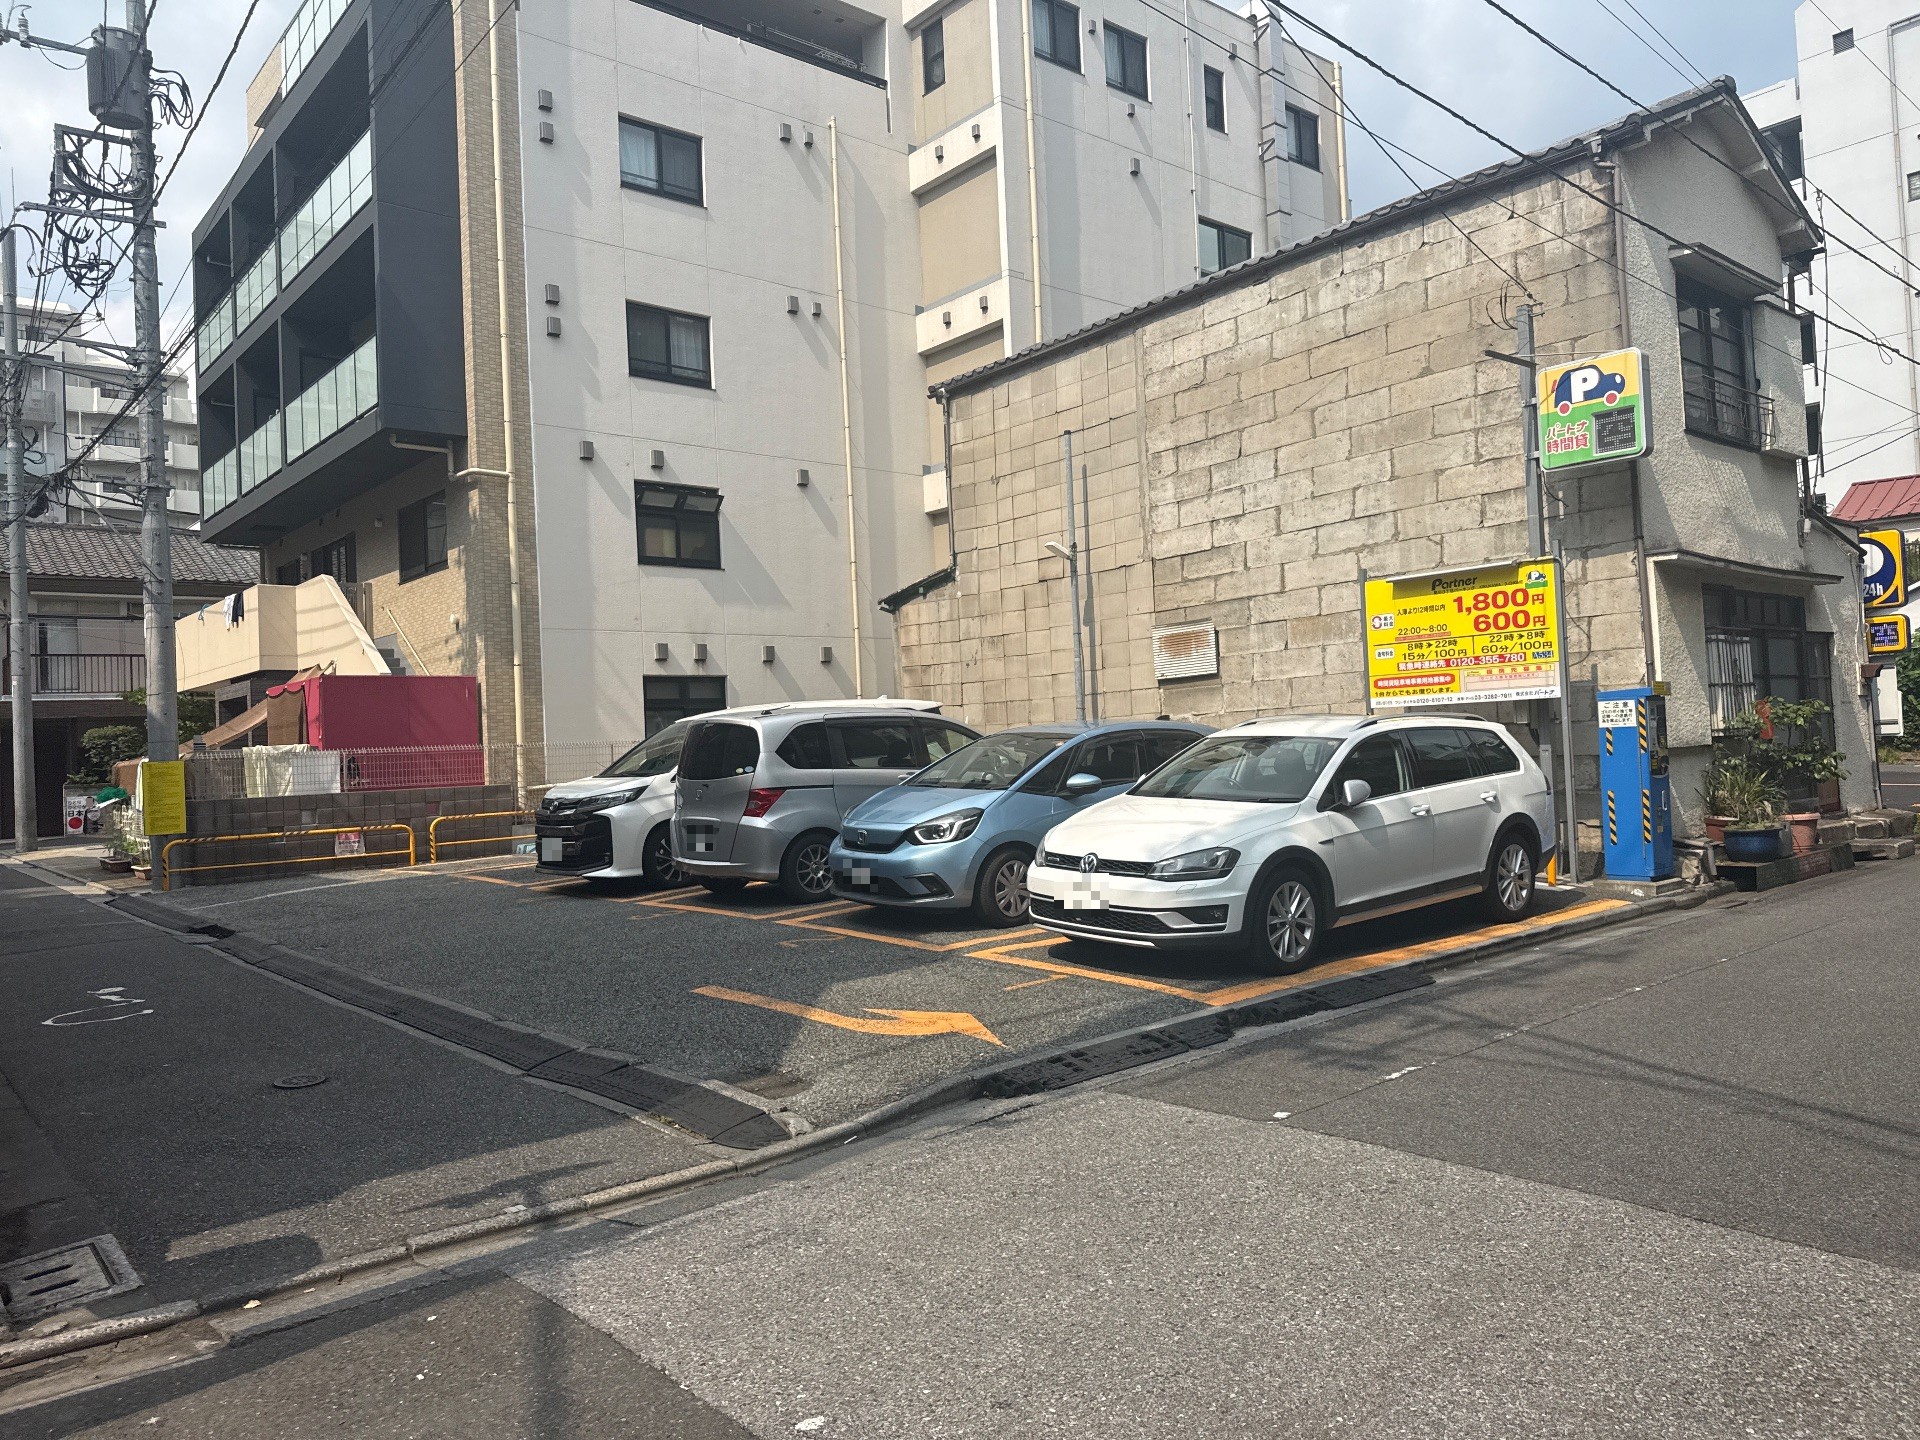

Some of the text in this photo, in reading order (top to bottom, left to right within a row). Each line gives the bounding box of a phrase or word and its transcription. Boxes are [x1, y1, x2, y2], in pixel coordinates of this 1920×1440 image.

[1571, 368, 1600, 404] P
[1546, 421, 1588, 439] パートナ
[1547, 433, 1588, 453] 時間貸
[1432, 576, 1478, 591] Partner
[1864, 583, 1884, 597] 24h
[1453, 588, 1545, 615] 1,800円
[1473, 610, 1546, 632] 600円
[1449, 653, 1525, 667] 0120-355-780
